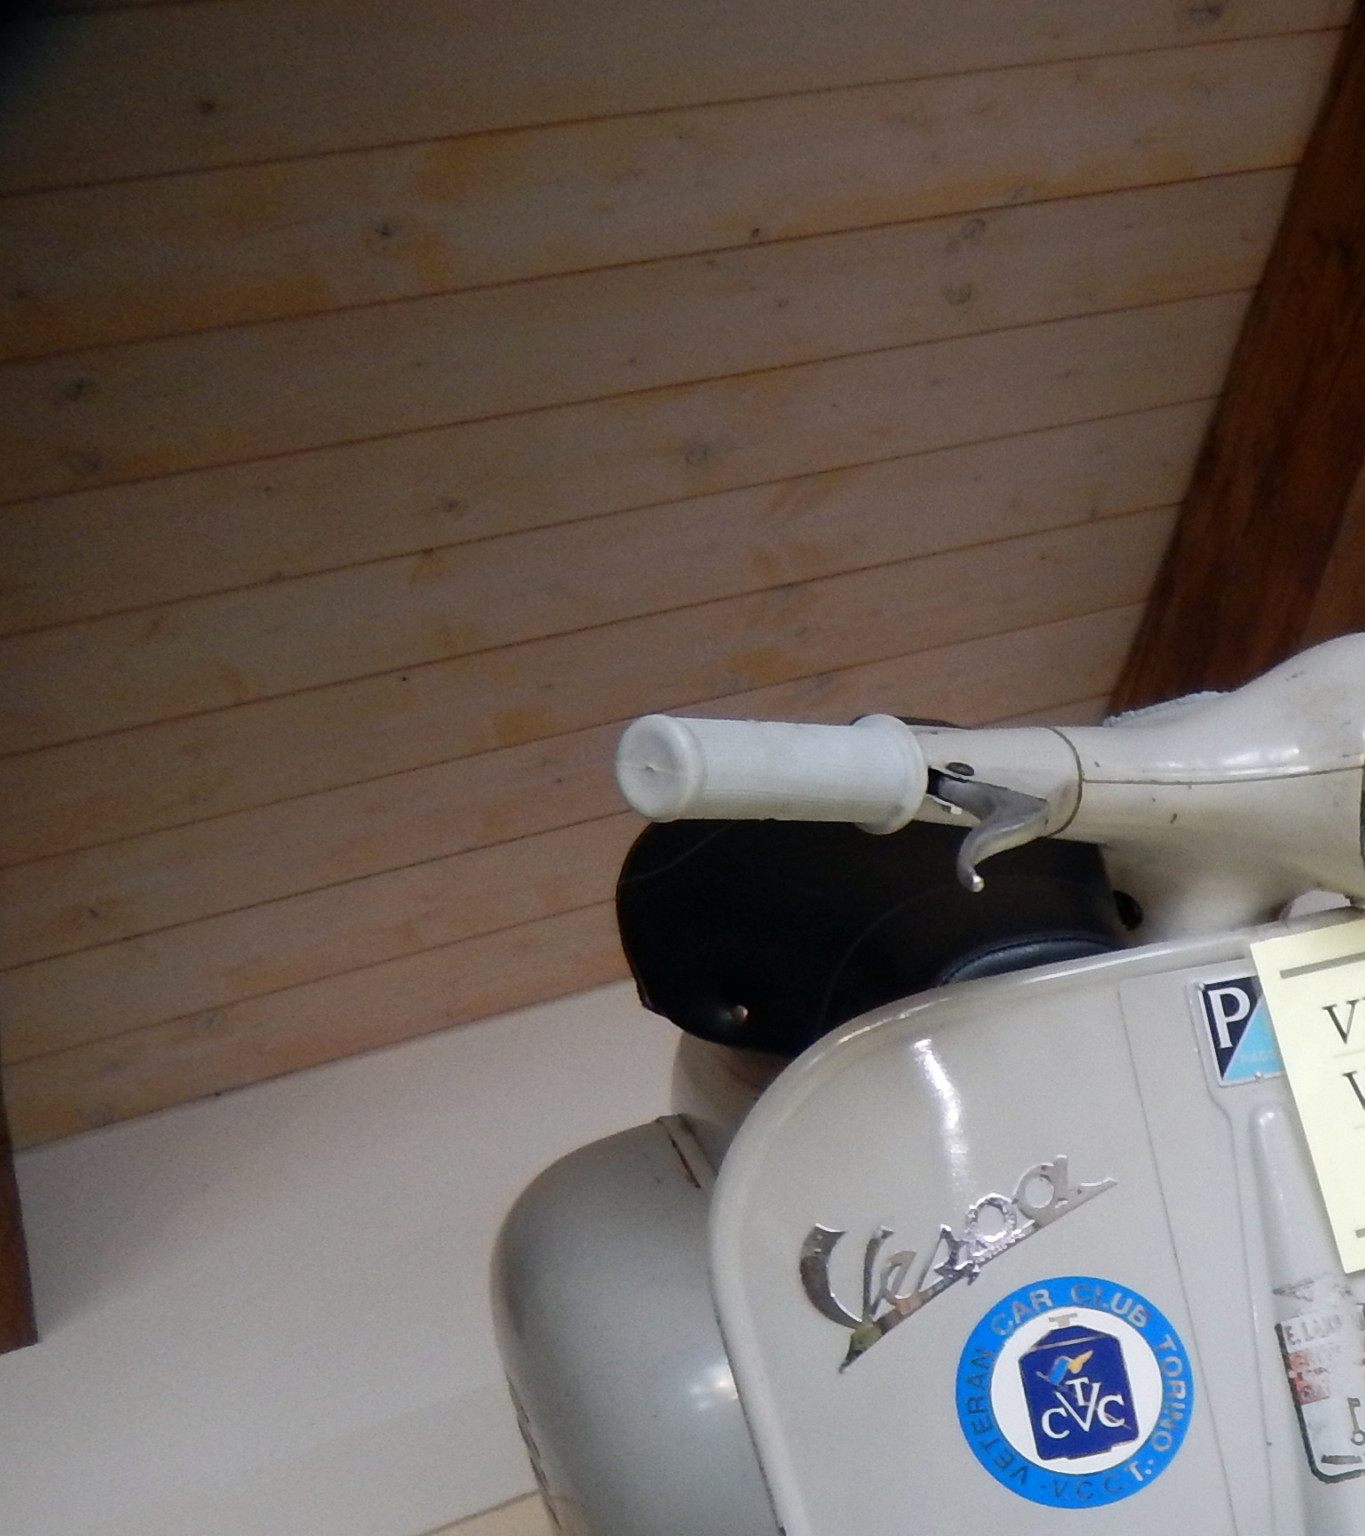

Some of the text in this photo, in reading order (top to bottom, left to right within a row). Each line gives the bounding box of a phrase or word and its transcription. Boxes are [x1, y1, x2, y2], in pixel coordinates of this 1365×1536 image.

[1207, 986, 1251, 1049] P
[800, 1153, 1118, 1373] Vespa
[990, 1287, 1055, 1338] CAR
[1070, 1284, 1152, 1329] CLUB
[1151, 1333, 1189, 1452] TORINO
